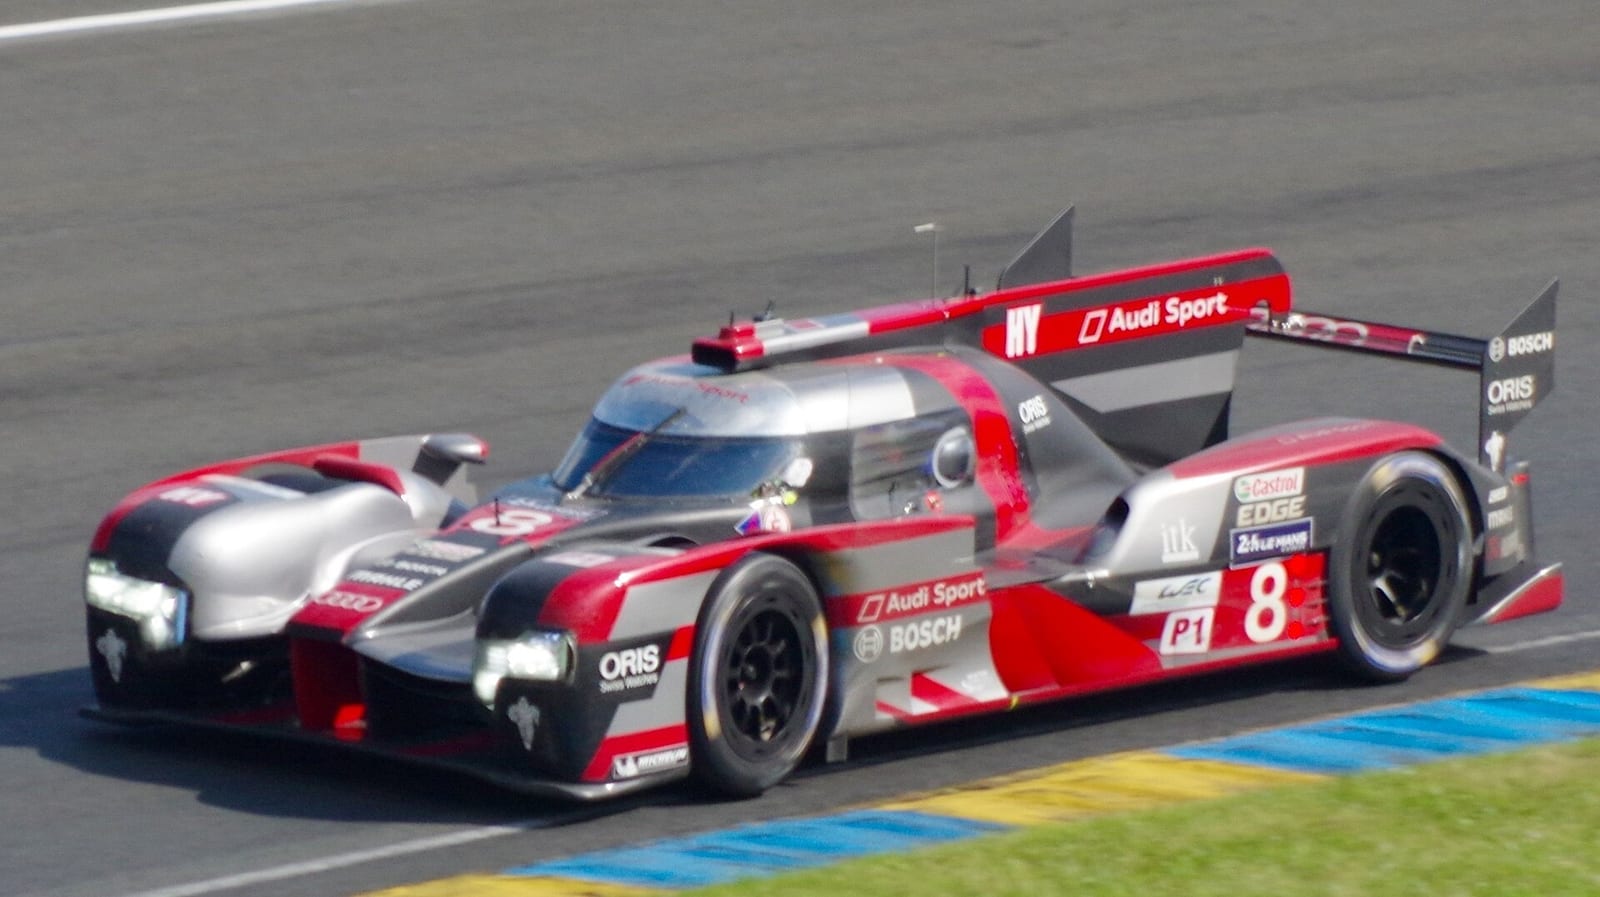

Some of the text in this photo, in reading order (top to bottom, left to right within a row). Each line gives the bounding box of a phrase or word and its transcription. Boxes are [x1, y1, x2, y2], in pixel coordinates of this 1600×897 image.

[1108, 292, 1228, 333] Audi Sport
[1005, 304, 1042, 358] HY
[1507, 331, 1554, 357] BOSCH
[1487, 375, 1534, 405] ORIS
[1018, 395, 1047, 424] ORIS
[1252, 475, 1298, 497] Castrol
[1236, 496, 1307, 527] EDGE
[886, 578, 986, 614] Audi Sport
[1158, 578, 1212, 599] WEC
[1244, 562, 1288, 643] 8
[889, 615, 962, 653] BOSCH
[1170, 616, 1205, 646] P1
[599, 644, 659, 680] ORIS
